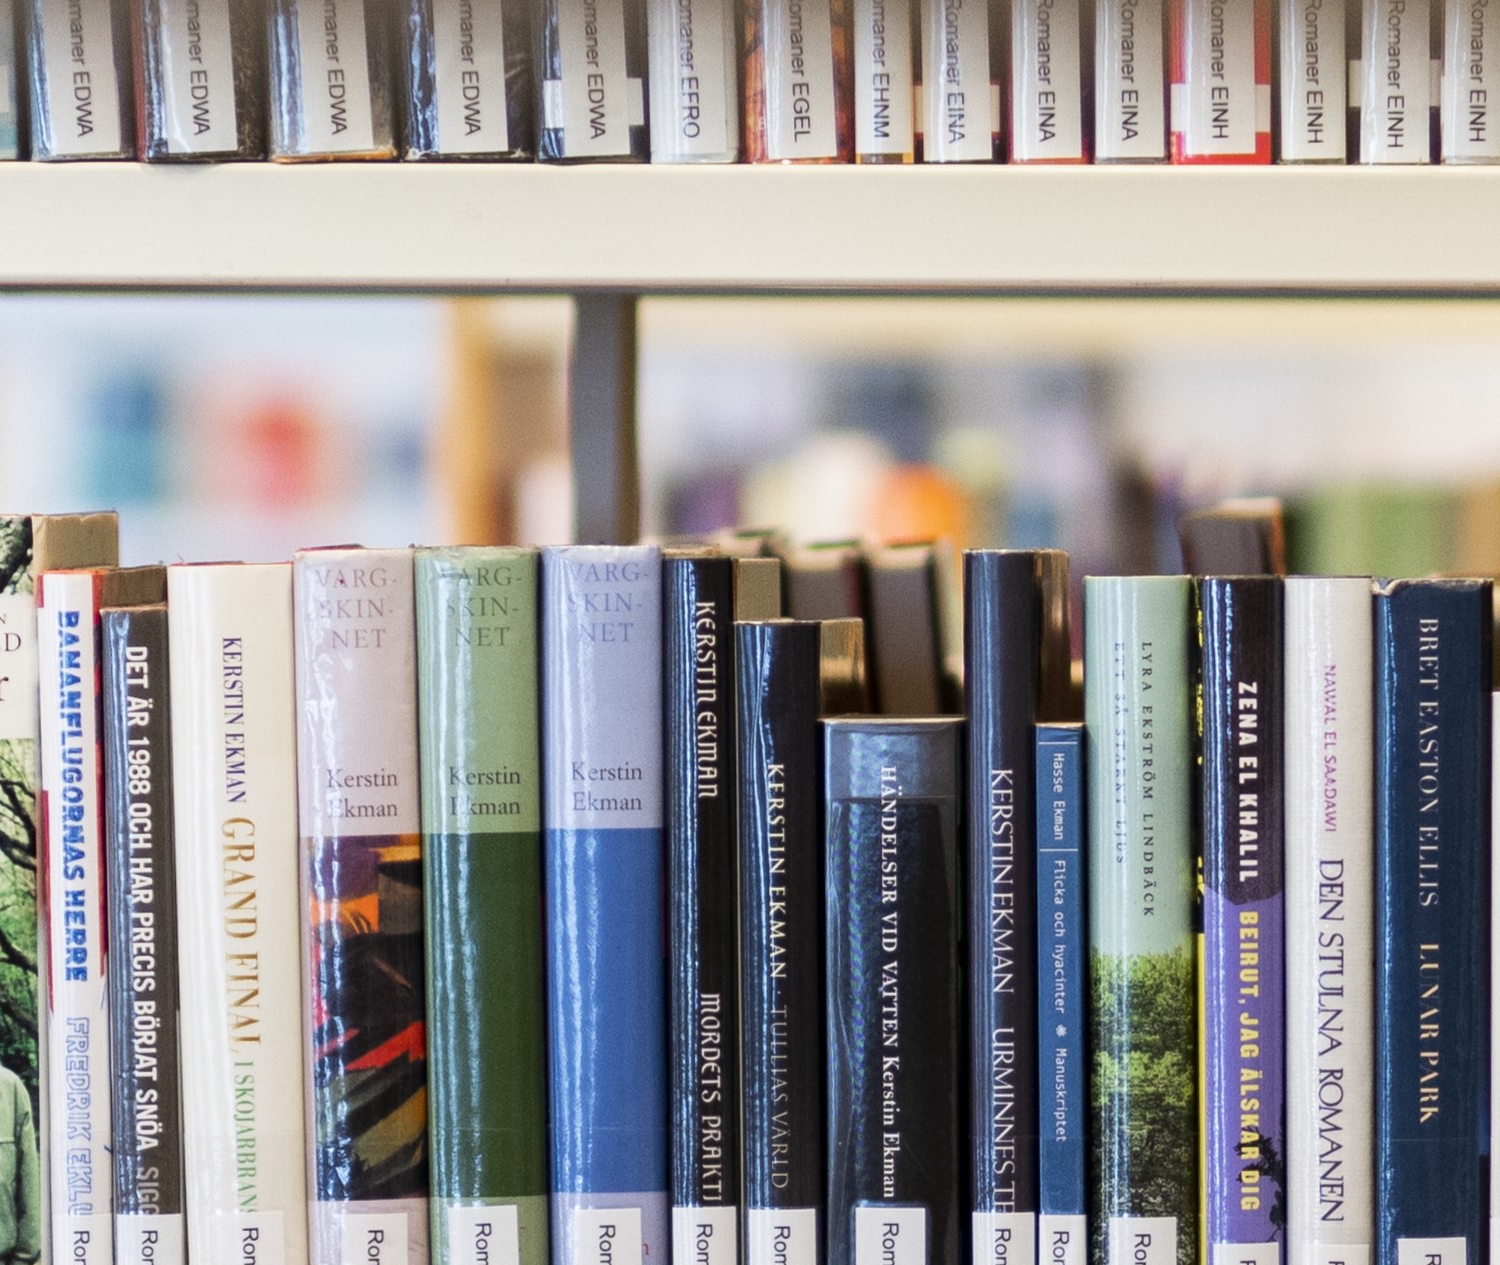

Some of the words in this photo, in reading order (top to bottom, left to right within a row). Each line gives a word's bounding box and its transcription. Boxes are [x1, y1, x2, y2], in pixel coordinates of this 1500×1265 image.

[461, 70, 481, 137] EDWA
[792, 75, 812, 142] EGEL
[1037, 91, 1055, 143] EINA
[1211, 85, 1229, 139] EINH
[1387, 94, 1404, 148] EINH
[126, 646, 149, 688] DET
[222, 637, 245, 725] KERSTIN
[1142, 642, 1153, 692] LYRA
[1419, 618, 1439, 690] BRET
[127, 696, 153, 726] ÄR
[1238, 682, 1258, 745] ZENA
[1324, 665, 1336, 724] NAWAL
[58, 611, 85, 881] BANANFLUGORNAS
[129, 737, 150, 794] 1988
[224, 733, 247, 803] EKMAN
[1052, 753, 1066, 792] Hasse
[1142, 706, 1156, 800] EKSTRÖM
[1239, 756, 1258, 784] EL
[1324, 732, 1337, 749] EL
[1419, 702, 1439, 812] EASTON
[130, 803, 152, 849] OCH
[1053, 801, 1066, 840] Ekman
[1324, 756, 1337, 832] SAADAWI
[880, 766, 903, 904] HÄNDELSER
[1143, 814, 1157, 917] LINDBÄCK
[1239, 794, 1259, 882] KHALIL
[1419, 826, 1439, 906] ELLIS
[131, 857, 153, 903] HAR
[221, 817, 258, 939] GRAND
[1053, 860, 1067, 904] Flicka
[1319, 859, 1344, 922] DEN
[65, 891, 88, 982] HERRE
[133, 912, 155, 991] PRECIS
[881, 912, 897, 952] VID
[1054, 912, 1067, 937] och
[1238, 911, 1259, 1004] BEIRUT,
[882, 961, 898, 1047] VATTEN
[1051, 944, 1068, 1013] hyacinter
[1319, 931, 1344, 1056] STULNA
[1419, 943, 1439, 1040] LUNAR
[133, 1001, 160, 1080] BÖRJAT
[1240, 1013, 1259, 1058] JAG
[135, 1090, 163, 1150] SNÖA
[882, 1055, 900, 1126] Kerstin
[1052, 1048, 1068, 1142] Manuskriptet
[1241, 1068, 1263, 1160] ÄLSKAR
[1419, 1052, 1439, 1124] PARK
[883, 1132, 900, 1198] Ekman
[1319, 1068, 1344, 1222] ROMANEN
[1241, 1170, 1260, 1210] DIG
